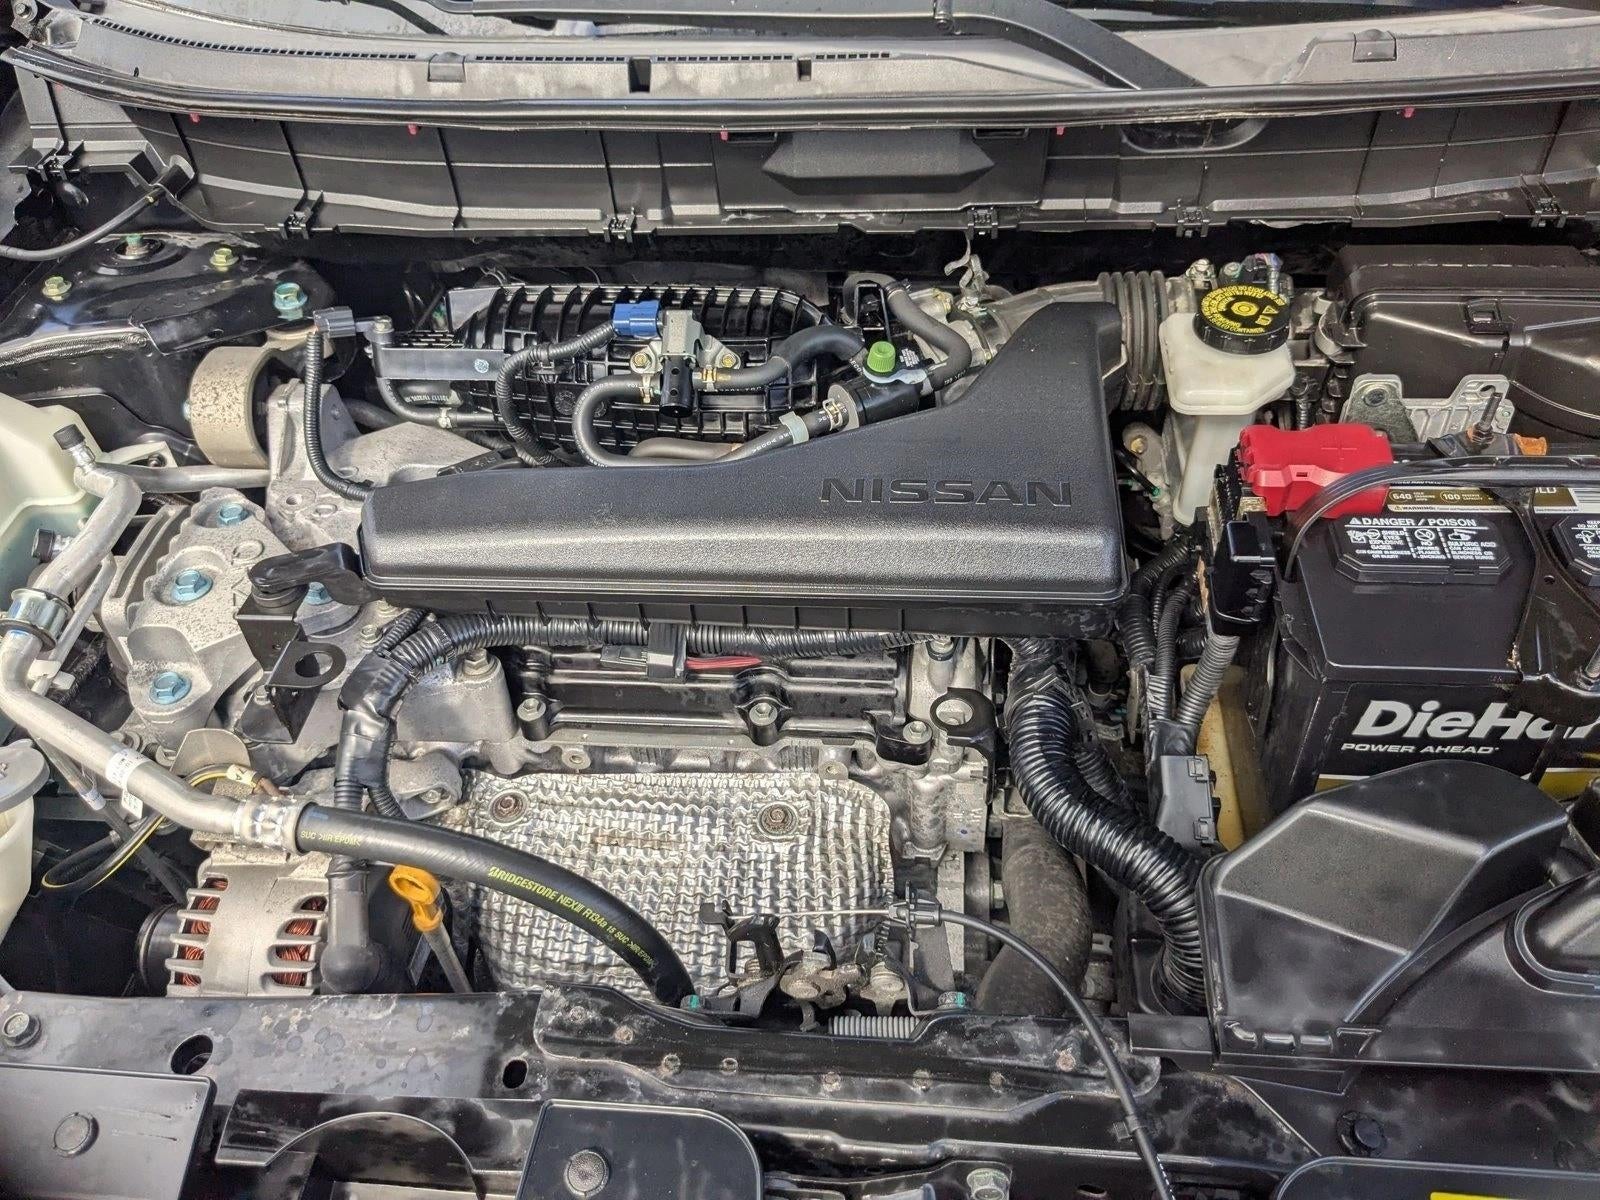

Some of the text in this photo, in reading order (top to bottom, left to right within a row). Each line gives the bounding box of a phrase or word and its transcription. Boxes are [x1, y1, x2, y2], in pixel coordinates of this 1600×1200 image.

[821, 478, 1071, 507] NISSAN
[1442, 492, 1461, 500] 100
[1362, 517, 1415, 526] DANGER
[1428, 518, 1477, 527] POISON
[1341, 743, 1494, 754] POWER AHEAD
[300, 830, 316, 840] SUC
[488, 866, 558, 900] BRIDGESTONE
[582, 908, 608, 930] R134a
